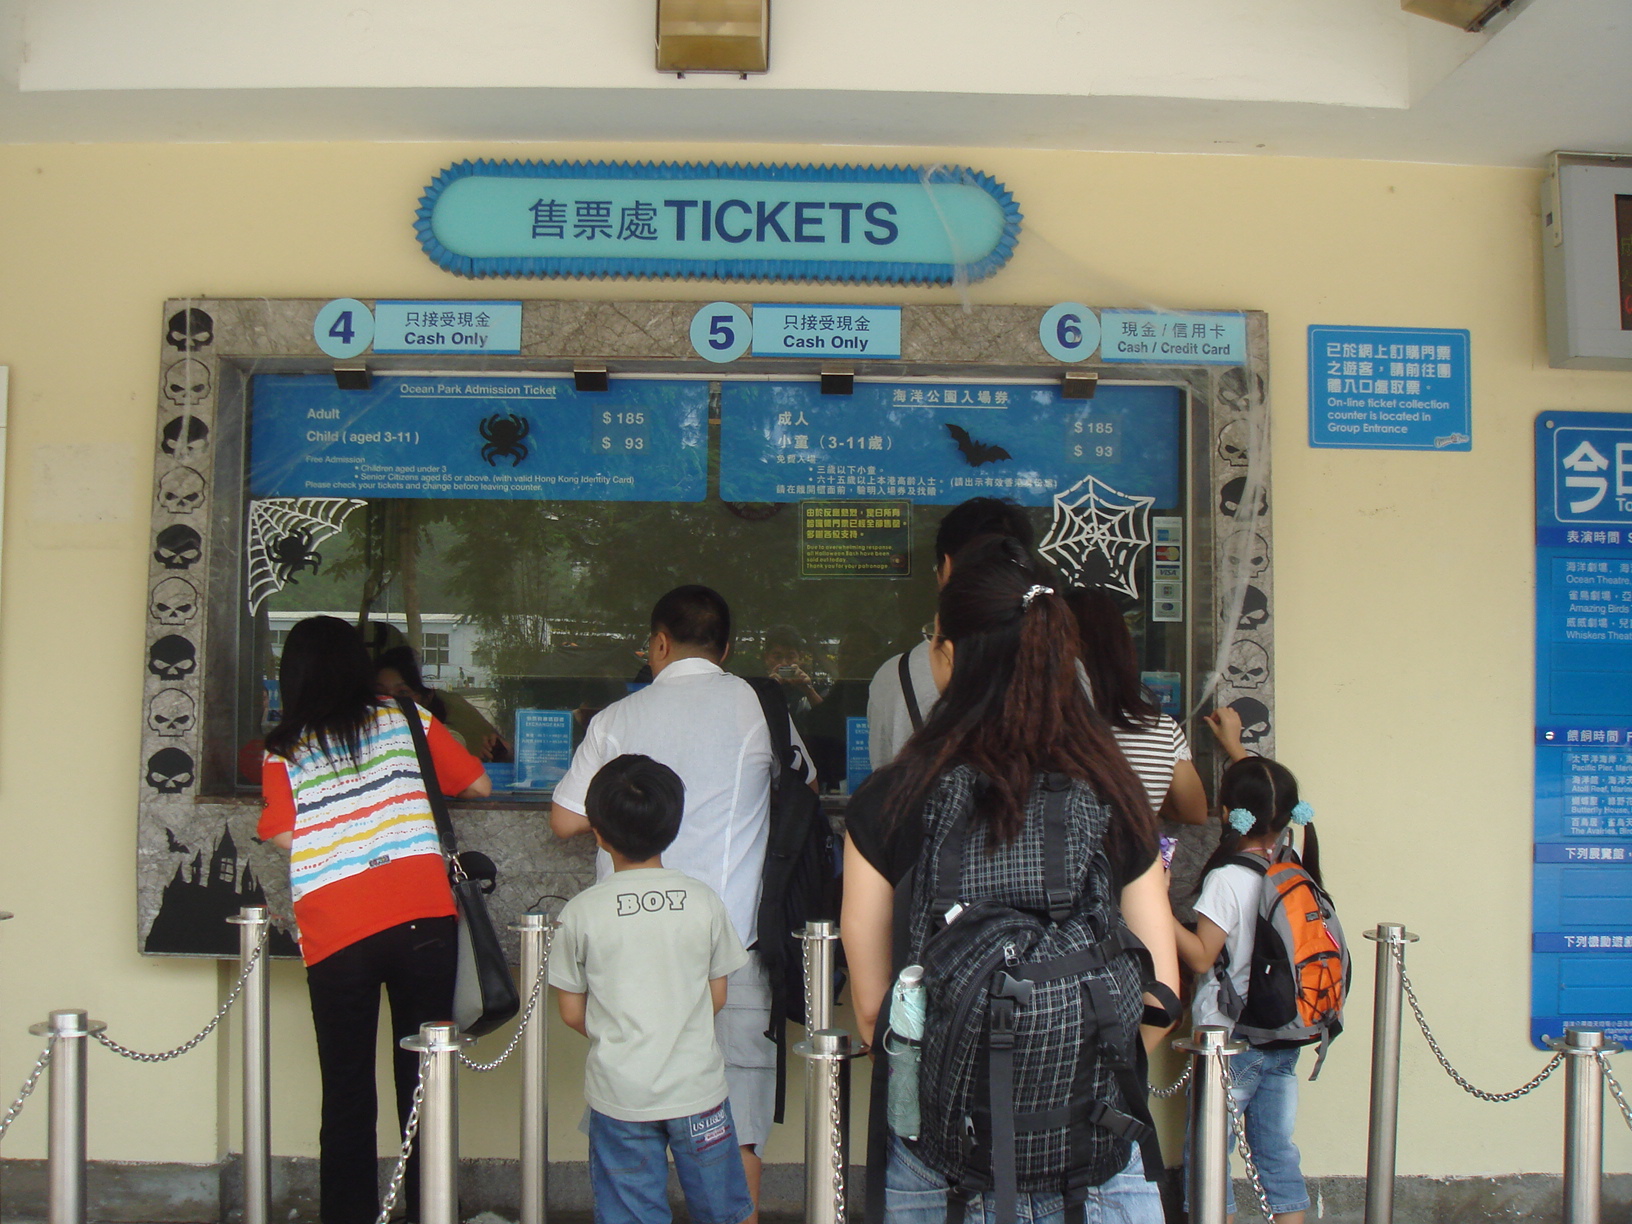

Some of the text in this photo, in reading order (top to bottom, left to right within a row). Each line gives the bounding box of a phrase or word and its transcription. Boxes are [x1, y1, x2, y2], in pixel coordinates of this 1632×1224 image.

[528, 198, 900, 246] 售票處 TICKETS
[405, 311, 491, 329] 只接受現金
[783, 314, 871, 333] 只接受現金
[328, 310, 355, 345] 4
[708, 315, 735, 350] 5
[1056, 313, 1083, 349] 6
[1121, 321, 1157, 338] 現金
[1172, 322, 1226, 340] 信用卡
[404, 331, 488, 349] Cash Only
[783, 334, 869, 352] Cash Only
[1117, 340, 1231, 356] Cash / Credit Card
[400, 383, 557, 396] Ocean Park Admission Ticket
[1327, 397, 1450, 410] On-line ticket collection
[306, 408, 341, 421] Adult
[602, 411, 645, 425] $ 185
[777, 411, 809, 427] 成人
[1327, 410, 1432, 422] counter is located in
[1074, 421, 1113, 435] $ 185
[1327, 422, 1409, 435] Group Entrance
[306, 430, 339, 443] Child
[602, 436, 644, 450] $ 93
[1073, 445, 1113, 458] $ 93
[305, 455, 366, 465] Free Admission
[360, 464, 447, 475] Children aged under 3
[360, 473, 386, 482] Senior
[388, 473, 419, 482] Citizens
[420, 474, 441, 483] aged
[442, 474, 453, 482] 65
[492, 474, 512, 484] (with
[513, 475, 533, 483] valid
[534, 475, 556, 485] Hong
[558, 475, 579, 485] Kong
[580, 476, 611, 485] Identity
[612, 475, 635, 485] Card)
[305, 480, 331, 489] Please
[332, 481, 357, 490] check
[358, 482, 376, 491] your
[377, 481, 404, 490] tickets
[405, 482, 421, 490] and
[422, 482, 452, 492] change
[453, 482, 479, 491] before
[480, 483, 509, 492] leaving
[1566, 530, 1620, 545] 表演時間
[1159, 569, 1177, 577] VISA
[1565, 574, 1596, 585] Ocean
[1569, 603, 1630, 616] Amazing Birds
[1566, 630, 1607, 641] Whiskers
[1571, 764, 1596, 772] Pacific
[1571, 784, 1590, 793] Atoll
[1571, 805, 1603, 816] Butterfly
[1570, 827, 1586, 836] The
[617, 889, 687, 917] BOY
